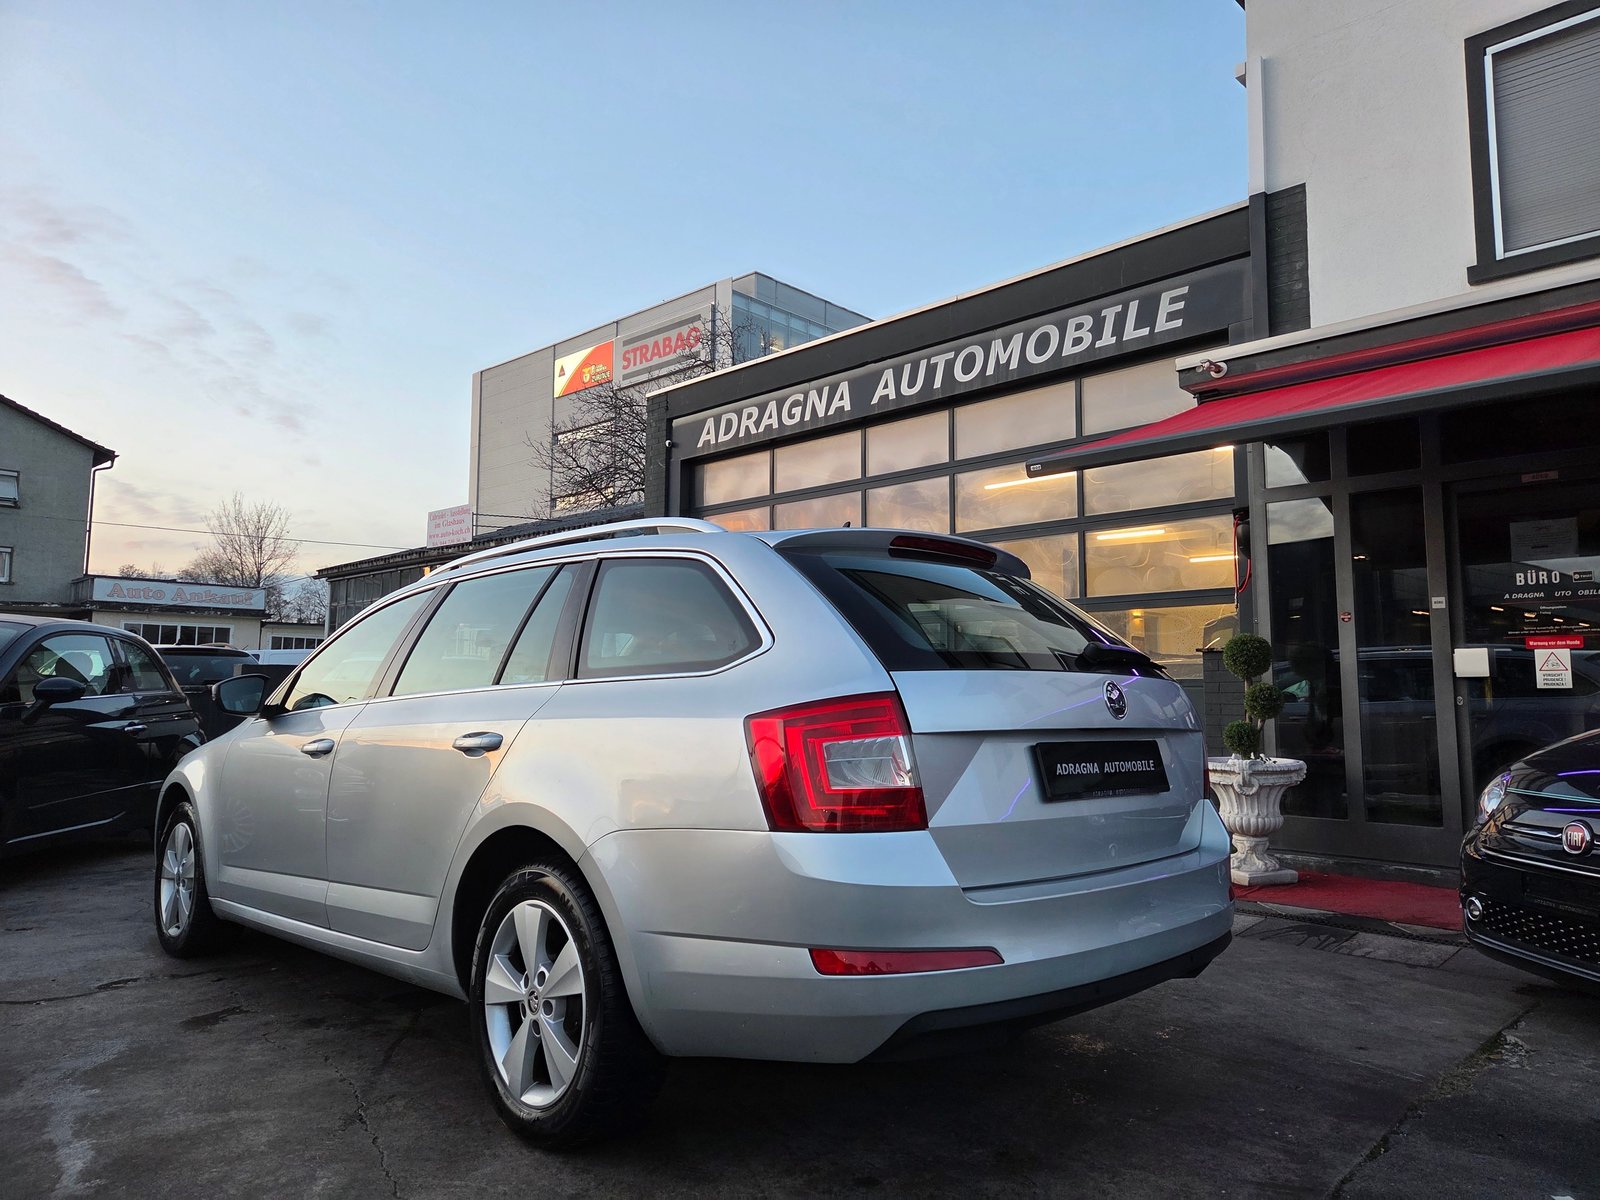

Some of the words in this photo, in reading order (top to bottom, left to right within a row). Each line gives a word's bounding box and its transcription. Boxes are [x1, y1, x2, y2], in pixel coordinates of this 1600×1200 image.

[697, 381, 851, 447] ADRAGNA
[871, 285, 1190, 405] AUTOMOBILE
[1516, 570, 1560, 586] BÜRO
[107, 583, 166, 600] Auto
[171, 587, 254, 606] Ankauf
[1056, 762, 1100, 775] ADRAGNA
[1104, 760, 1155, 773] AUTOMOBILE
[1567, 831, 1583, 846] FIAT
